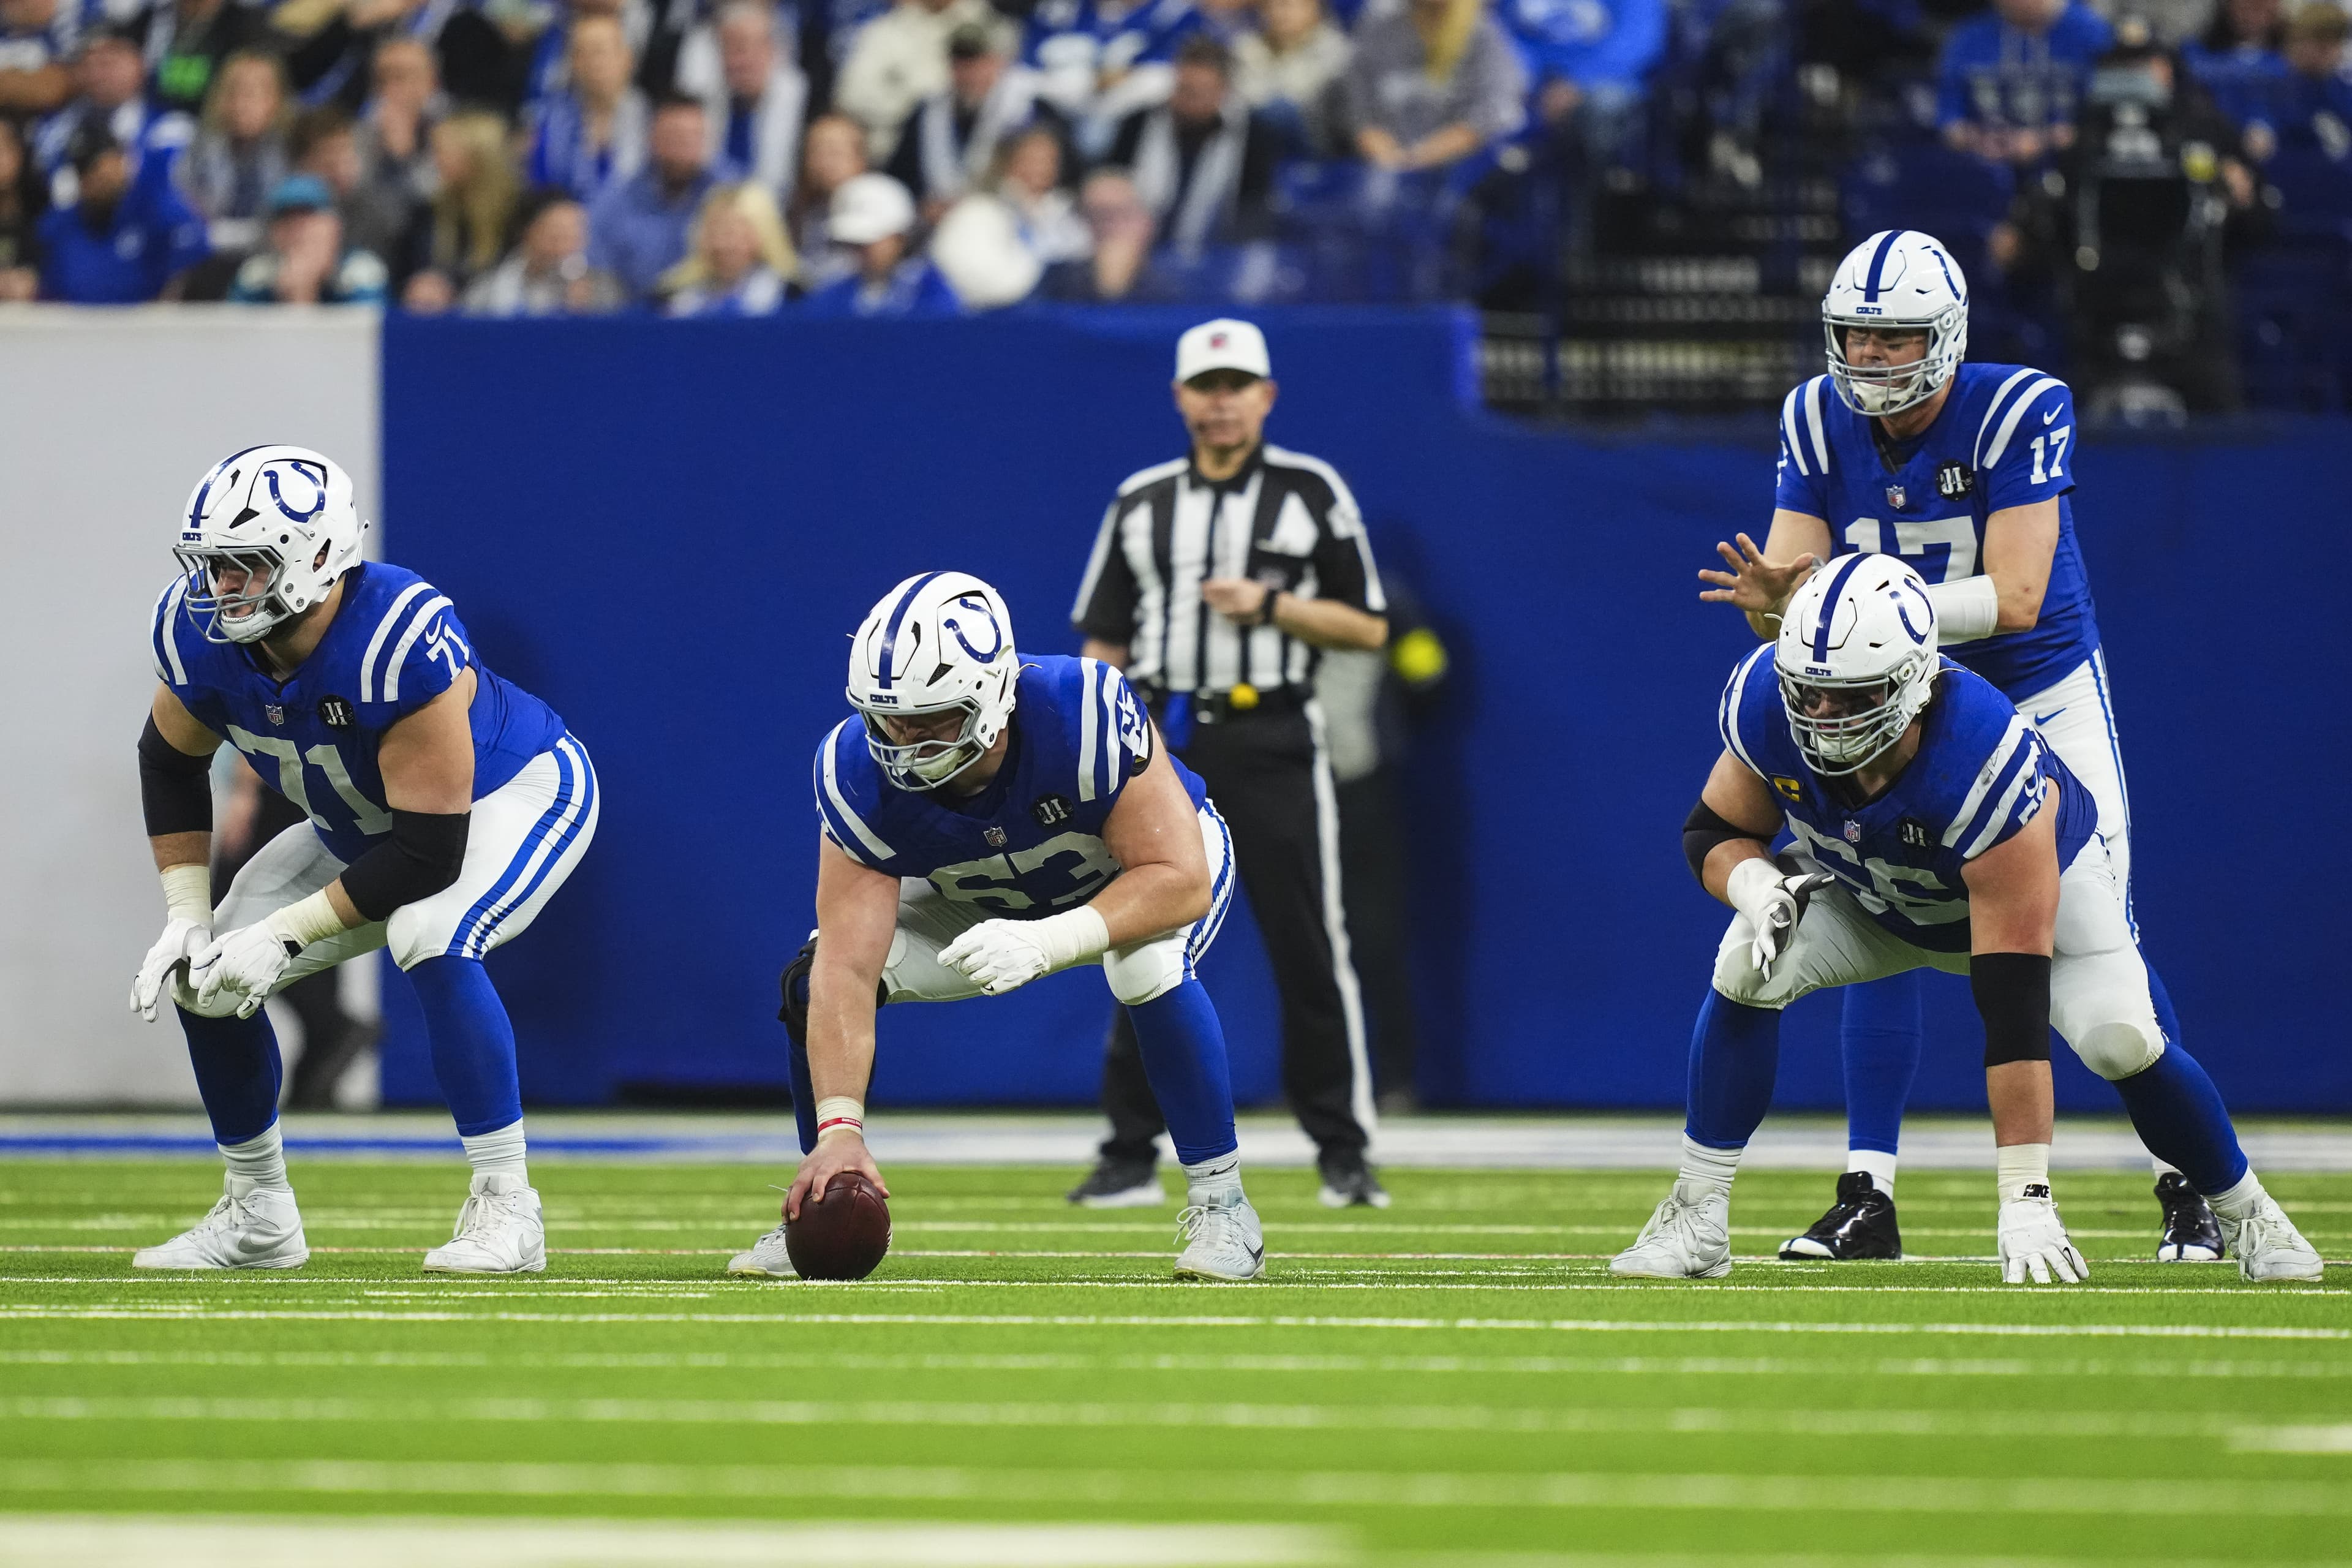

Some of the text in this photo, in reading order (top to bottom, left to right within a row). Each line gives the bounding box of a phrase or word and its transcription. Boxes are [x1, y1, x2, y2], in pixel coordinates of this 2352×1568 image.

[2030, 424, 2070, 484] 17
[426, 623, 470, 683] 71
[1806, 666, 1831, 677] COLTS
[870, 694, 898, 704] COLTS
[225, 724, 393, 835] 71
[926, 831, 1120, 910] 63
